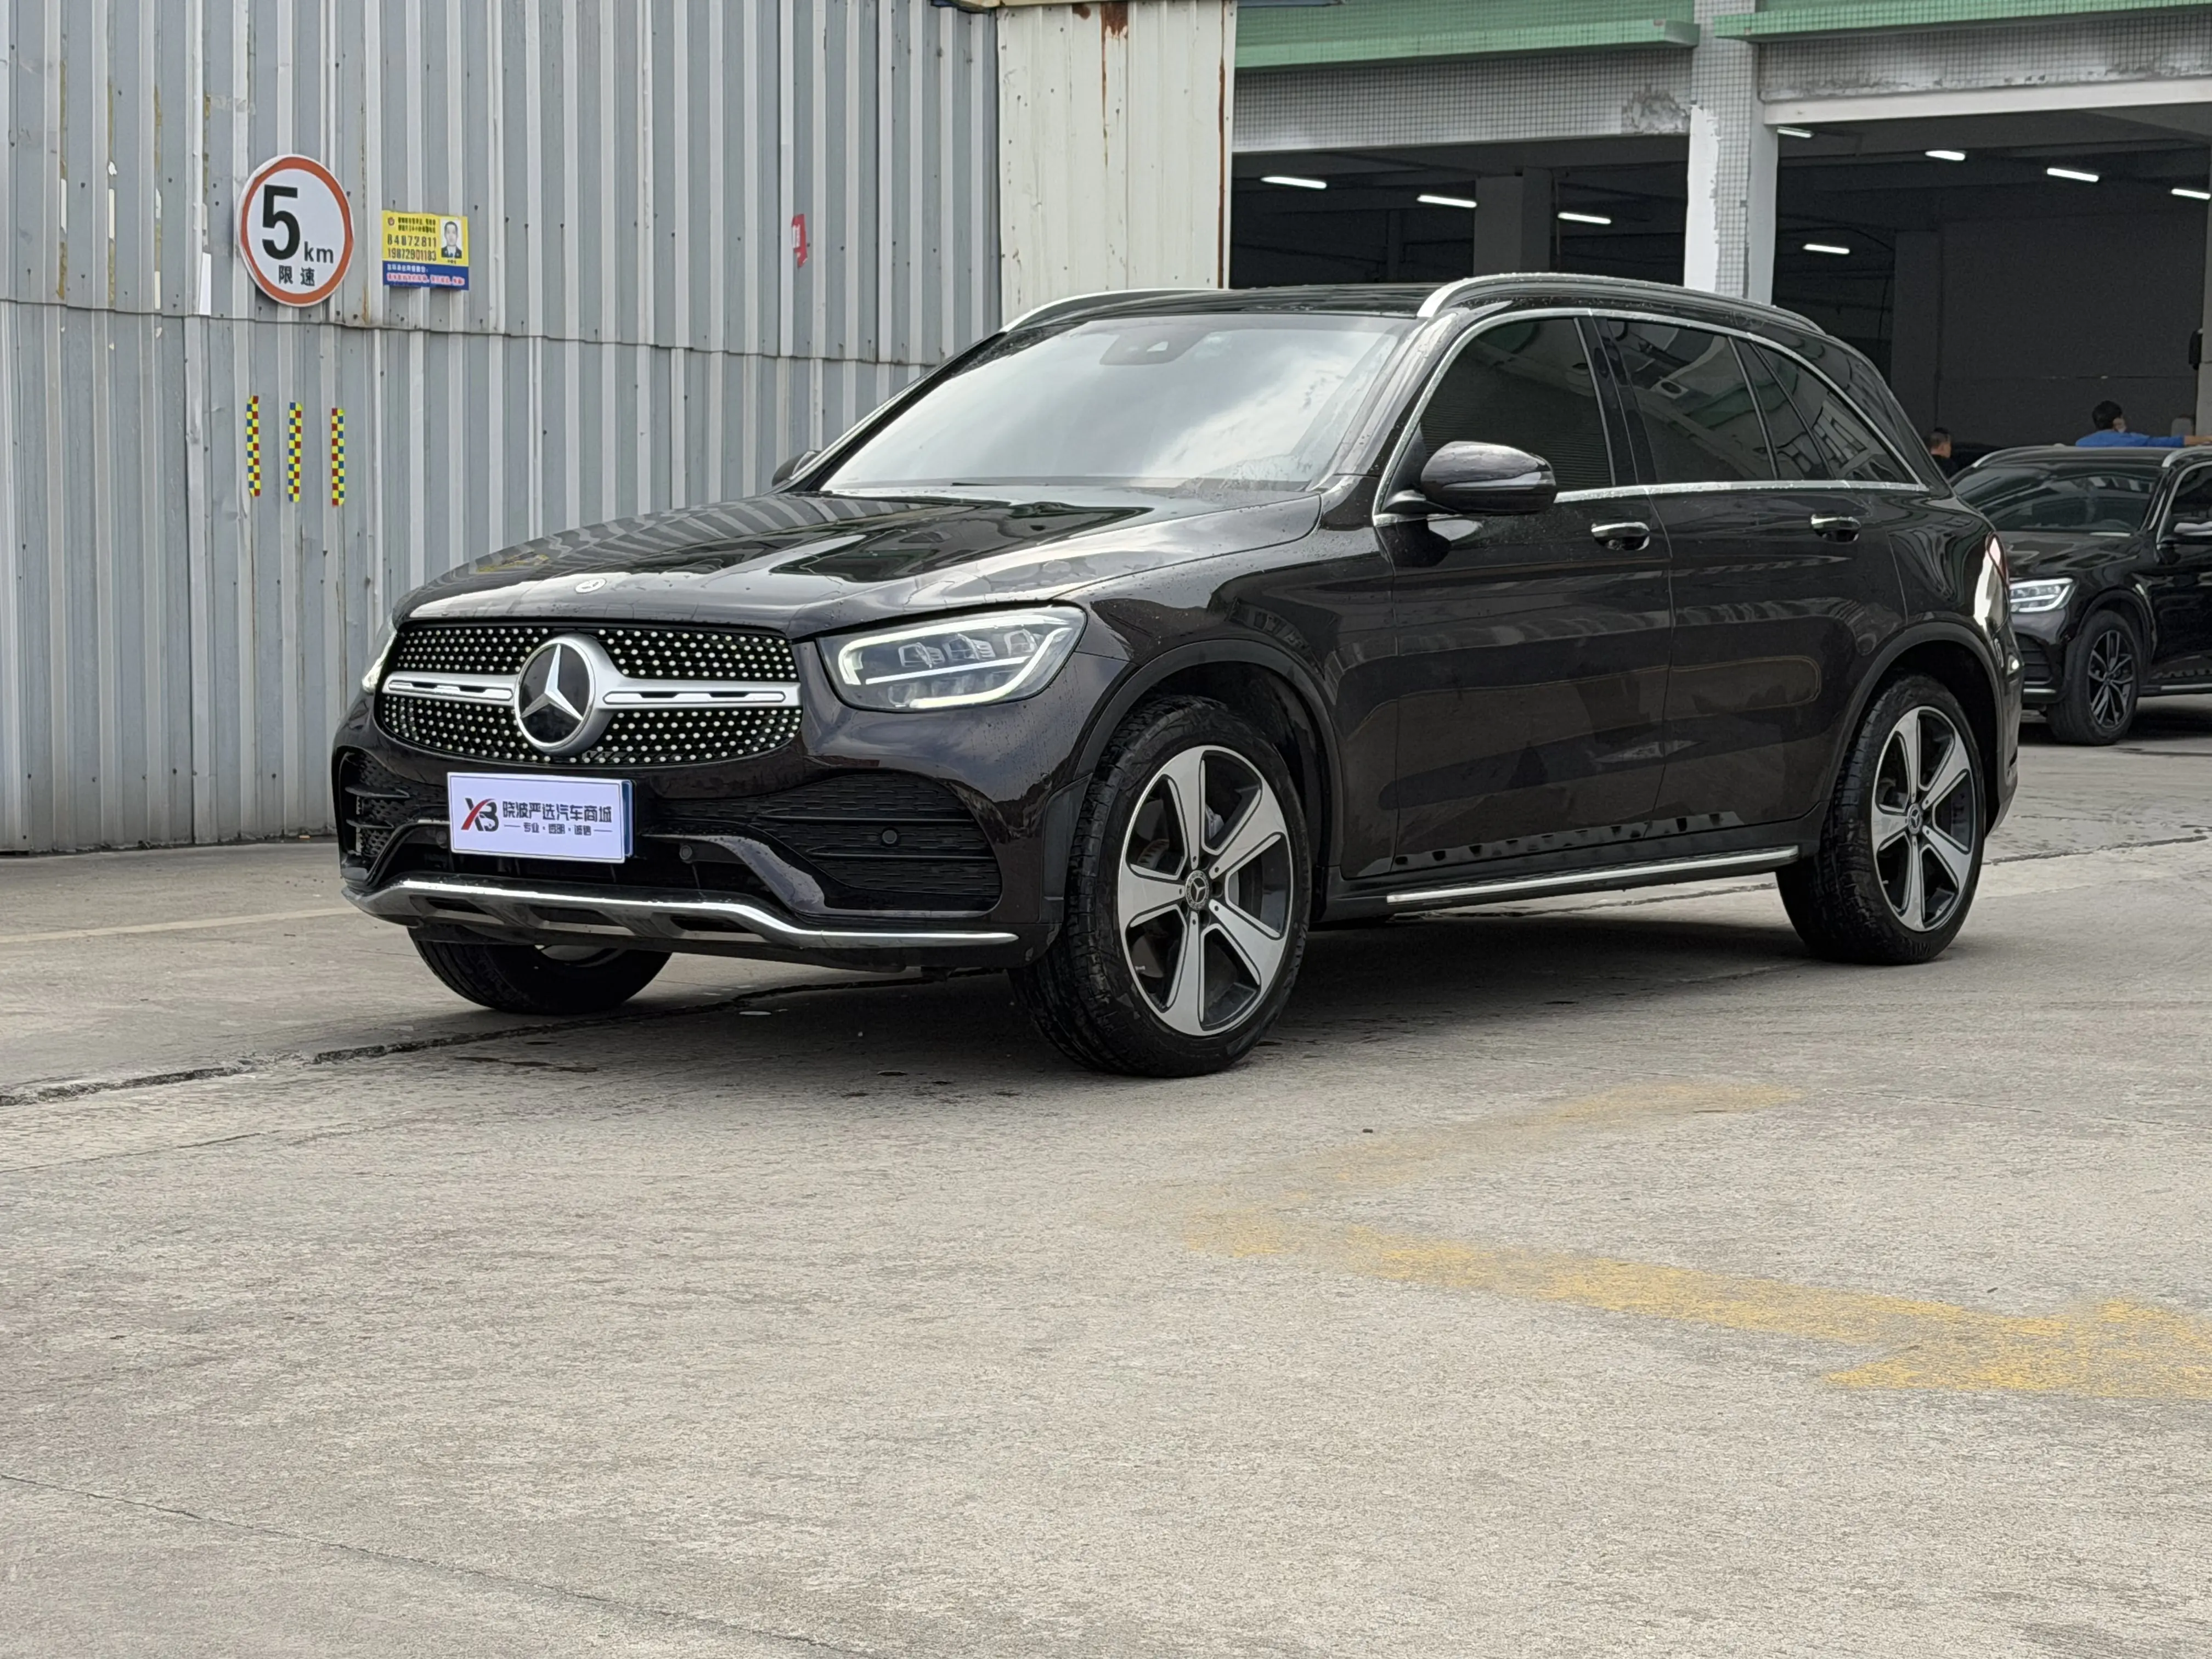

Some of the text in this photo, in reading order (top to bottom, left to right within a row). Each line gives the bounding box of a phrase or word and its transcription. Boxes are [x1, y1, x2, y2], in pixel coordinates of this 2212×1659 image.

[262, 184, 334, 264] 5 km
[278, 265, 315, 286] 限速
[503, 801, 612, 823] 晓波严选汽车商城
